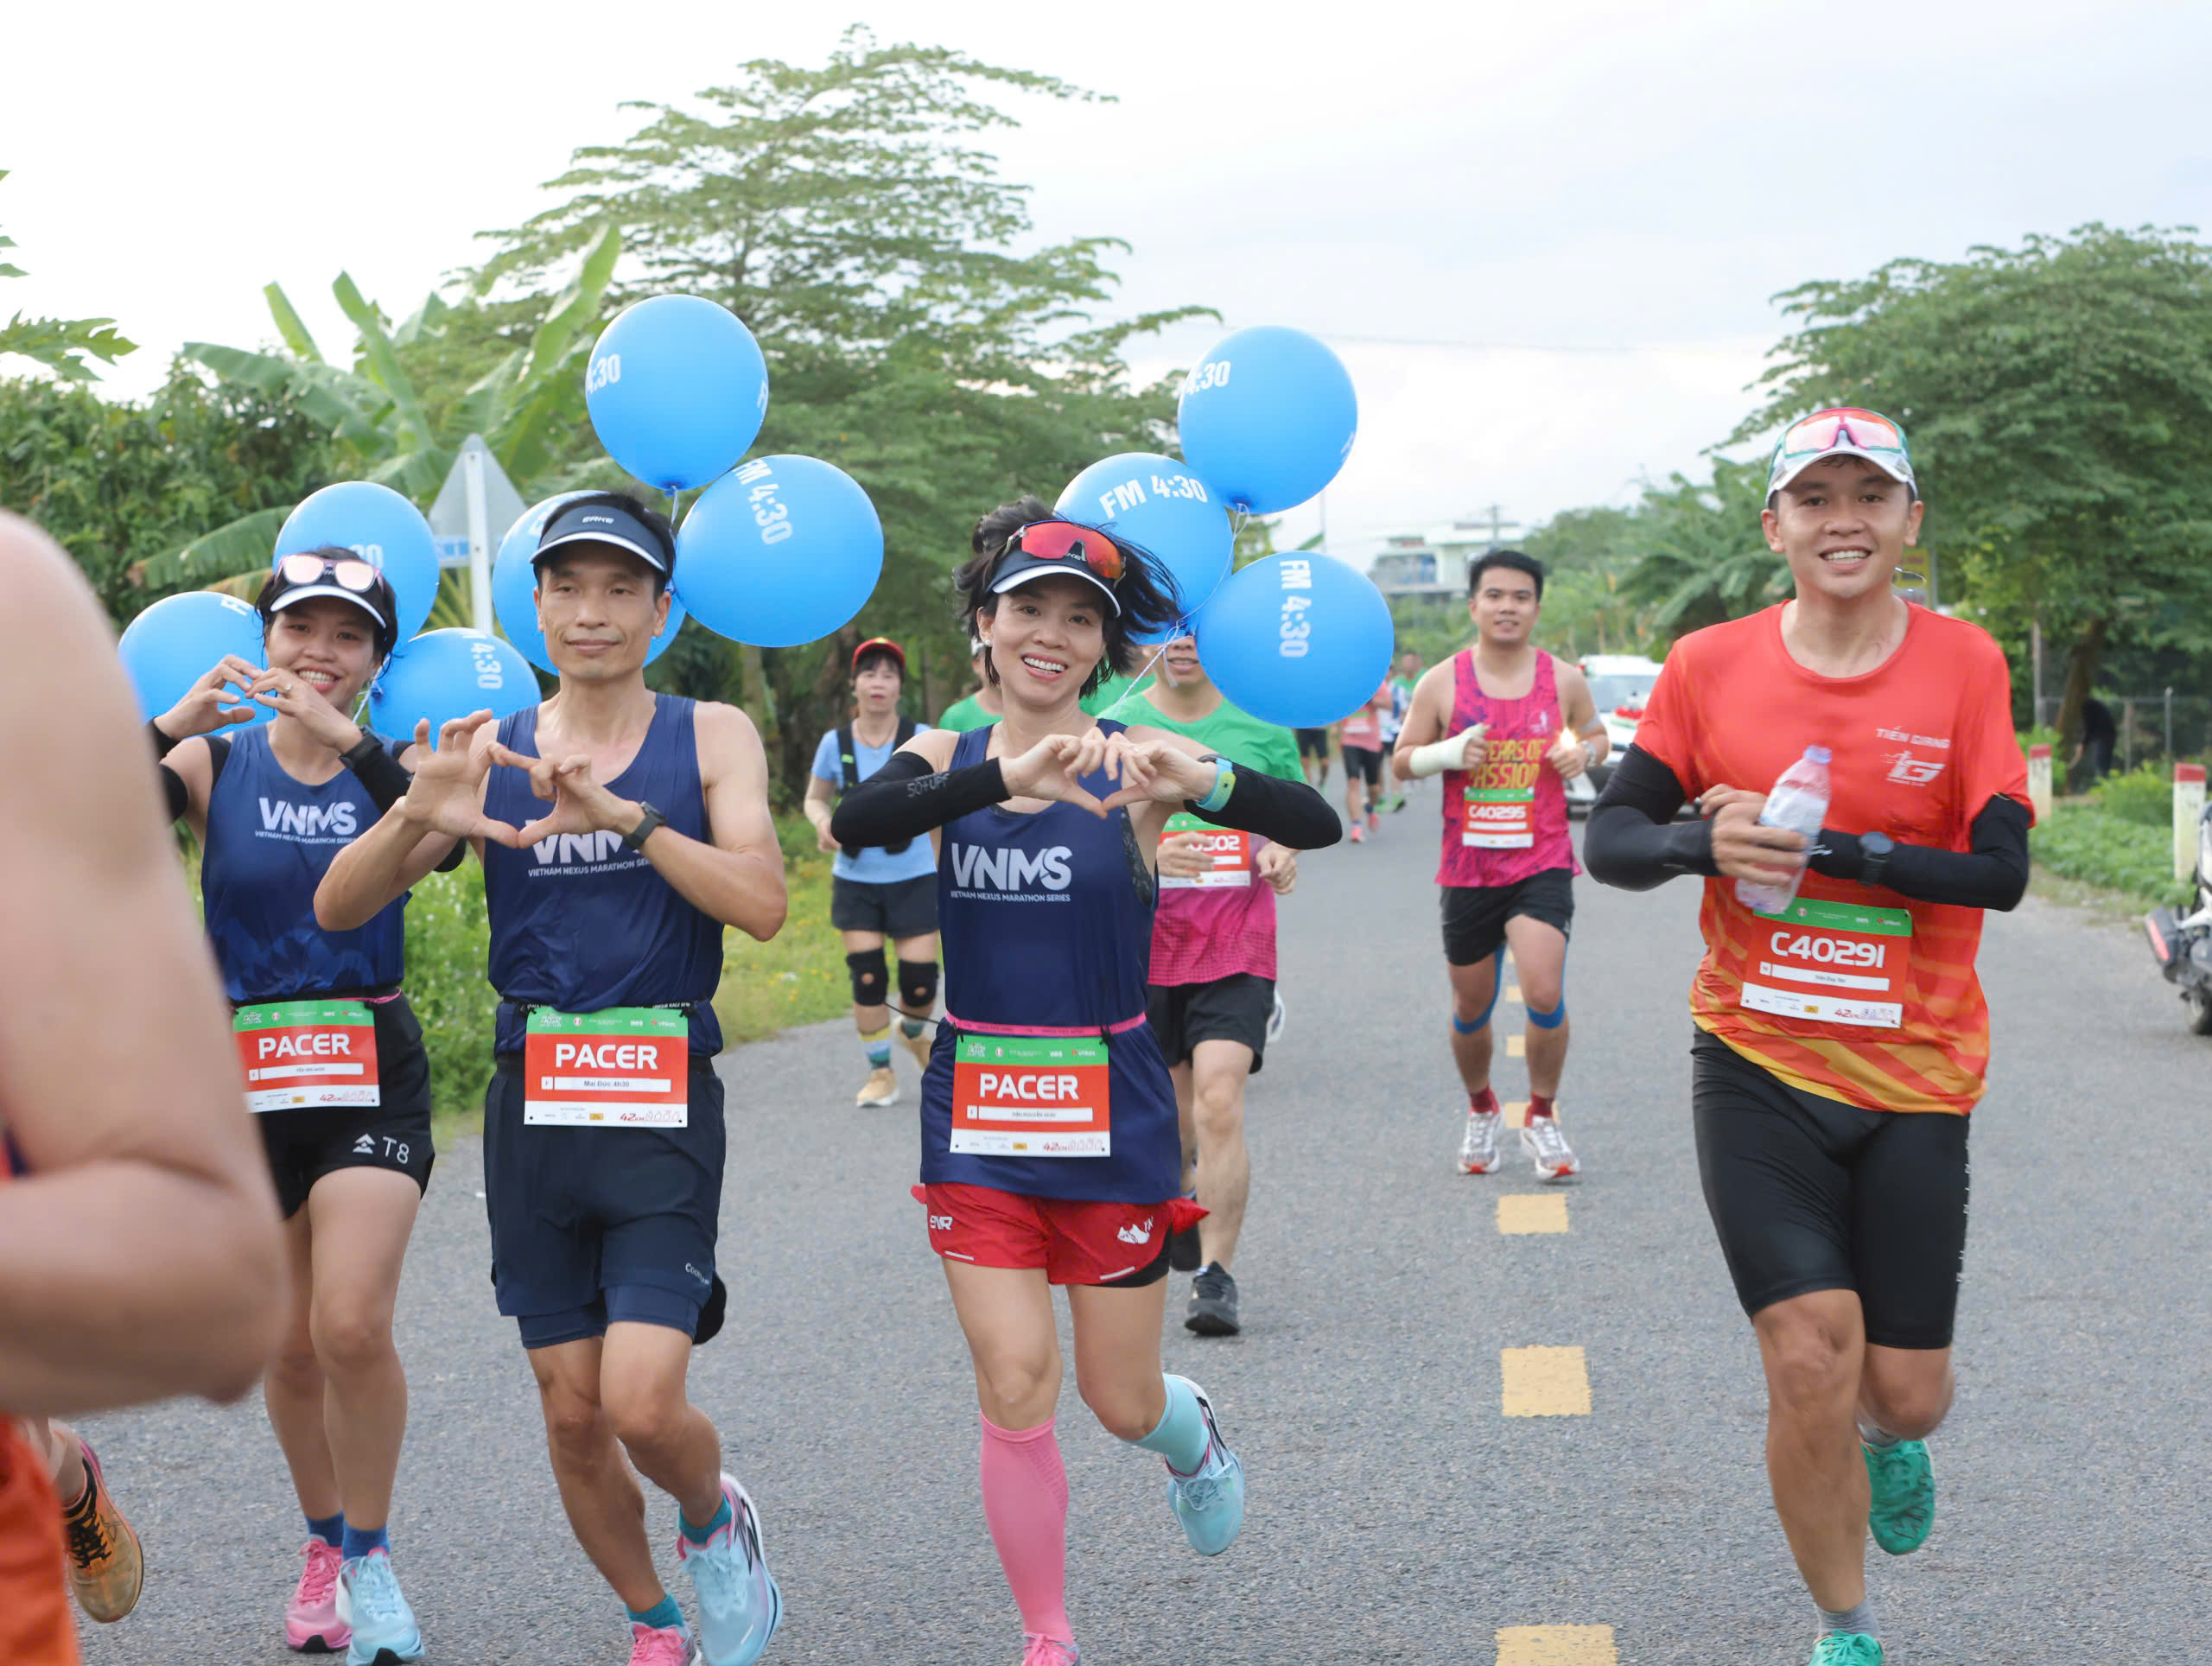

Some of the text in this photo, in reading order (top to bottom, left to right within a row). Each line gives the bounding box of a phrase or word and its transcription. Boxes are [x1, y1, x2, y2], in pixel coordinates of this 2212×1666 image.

[733, 459, 793, 544] FM 4:30
[1098, 475, 1208, 519] FM 4:30
[1280, 560, 1312, 658] FM 4:30
[471, 642, 503, 689] 4:30
[1470, 761, 1541, 789] ASSION
[258, 797, 358, 836] VNMS
[255, 830, 282, 840] VIETNAM
[302, 836, 335, 844] MARATHON
[525, 819, 640, 865] VNM
[528, 865, 563, 878] VIETNAM
[563, 865, 589, 876] NEXUS
[590, 862, 635, 874] MARATHON
[951, 843, 1073, 892] VNMS
[976, 893, 1001, 901] NEXUS
[1002, 893, 1046, 903] MARATHON
[1046, 893, 1071, 903] SERIES
[1770, 932, 1885, 969] C40291
[258, 1033, 352, 1060] PACER
[556, 1043, 658, 1070] PACER
[979, 1072, 1079, 1100] PACER
[383, 1136, 410, 1165] T8
